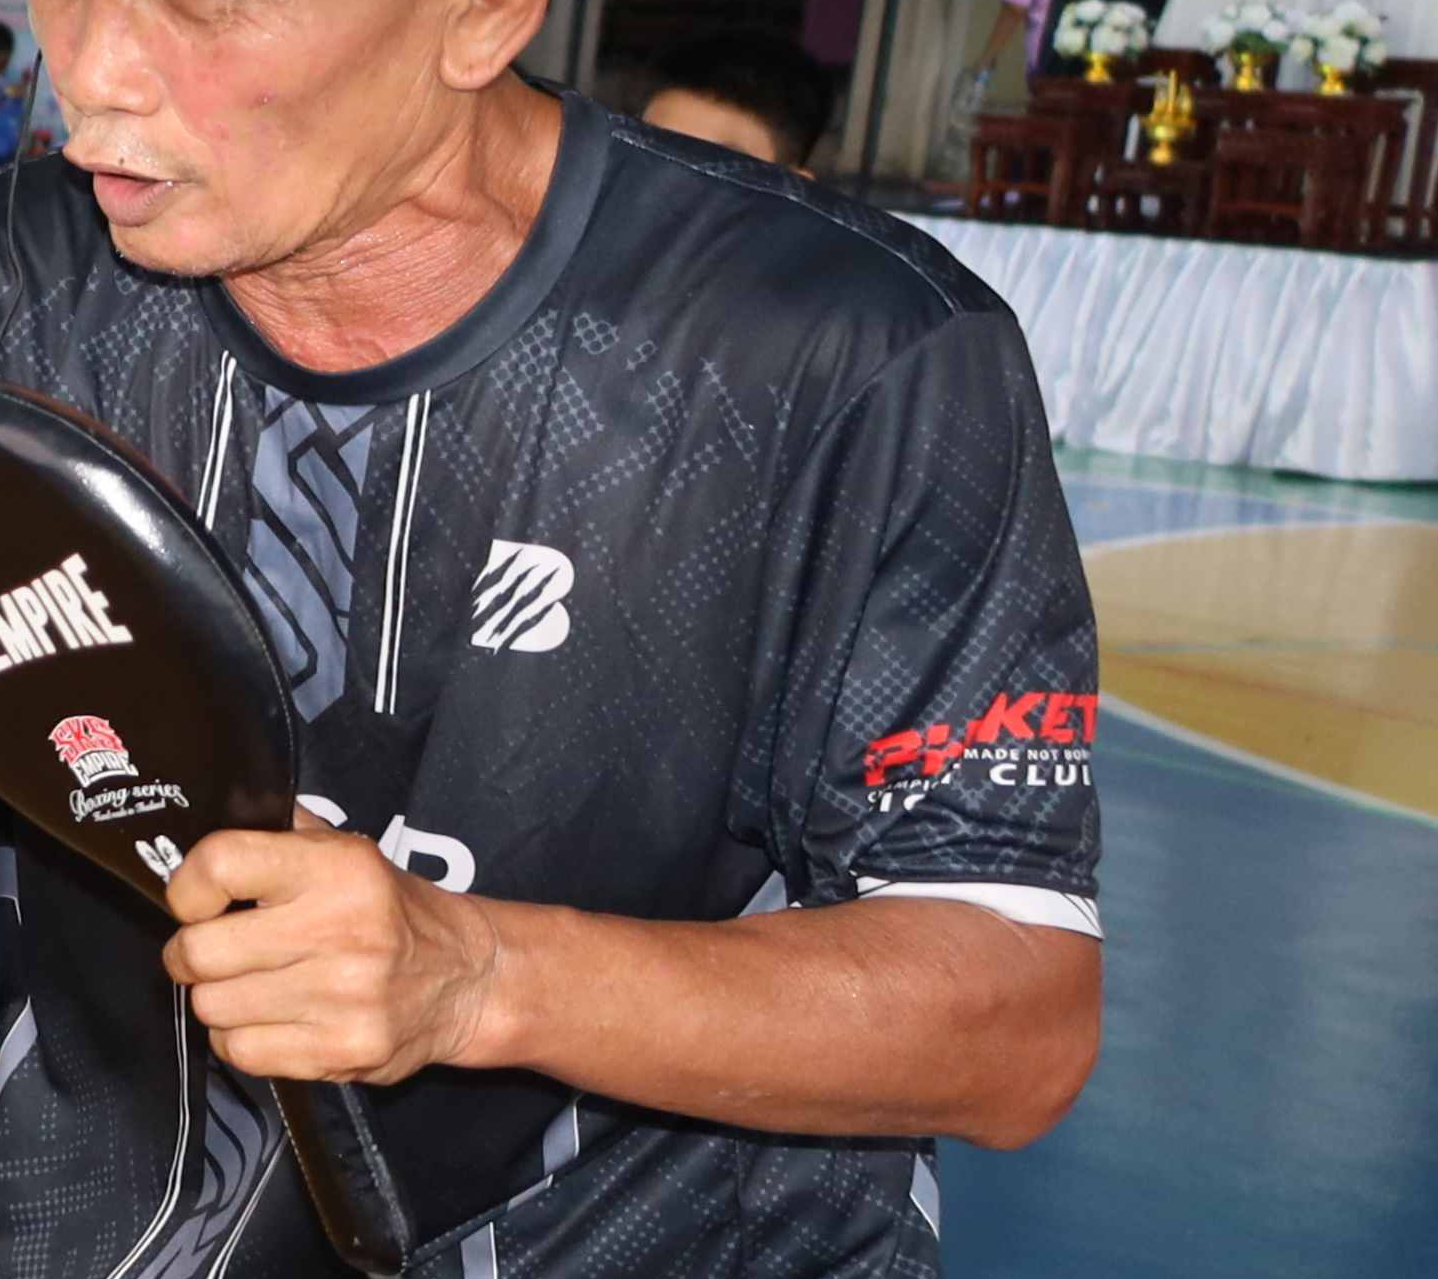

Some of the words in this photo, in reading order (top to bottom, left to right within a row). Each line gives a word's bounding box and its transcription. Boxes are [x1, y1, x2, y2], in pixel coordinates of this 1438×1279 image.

[48, 715, 129, 766] SKS
[964, 747, 1020, 762] MADE
[1026, 747, 1058, 762] NOT
[70, 749, 140, 789] EMPIRE
[68, 786, 128, 823] Boxing
[132, 778, 190, 808] series
